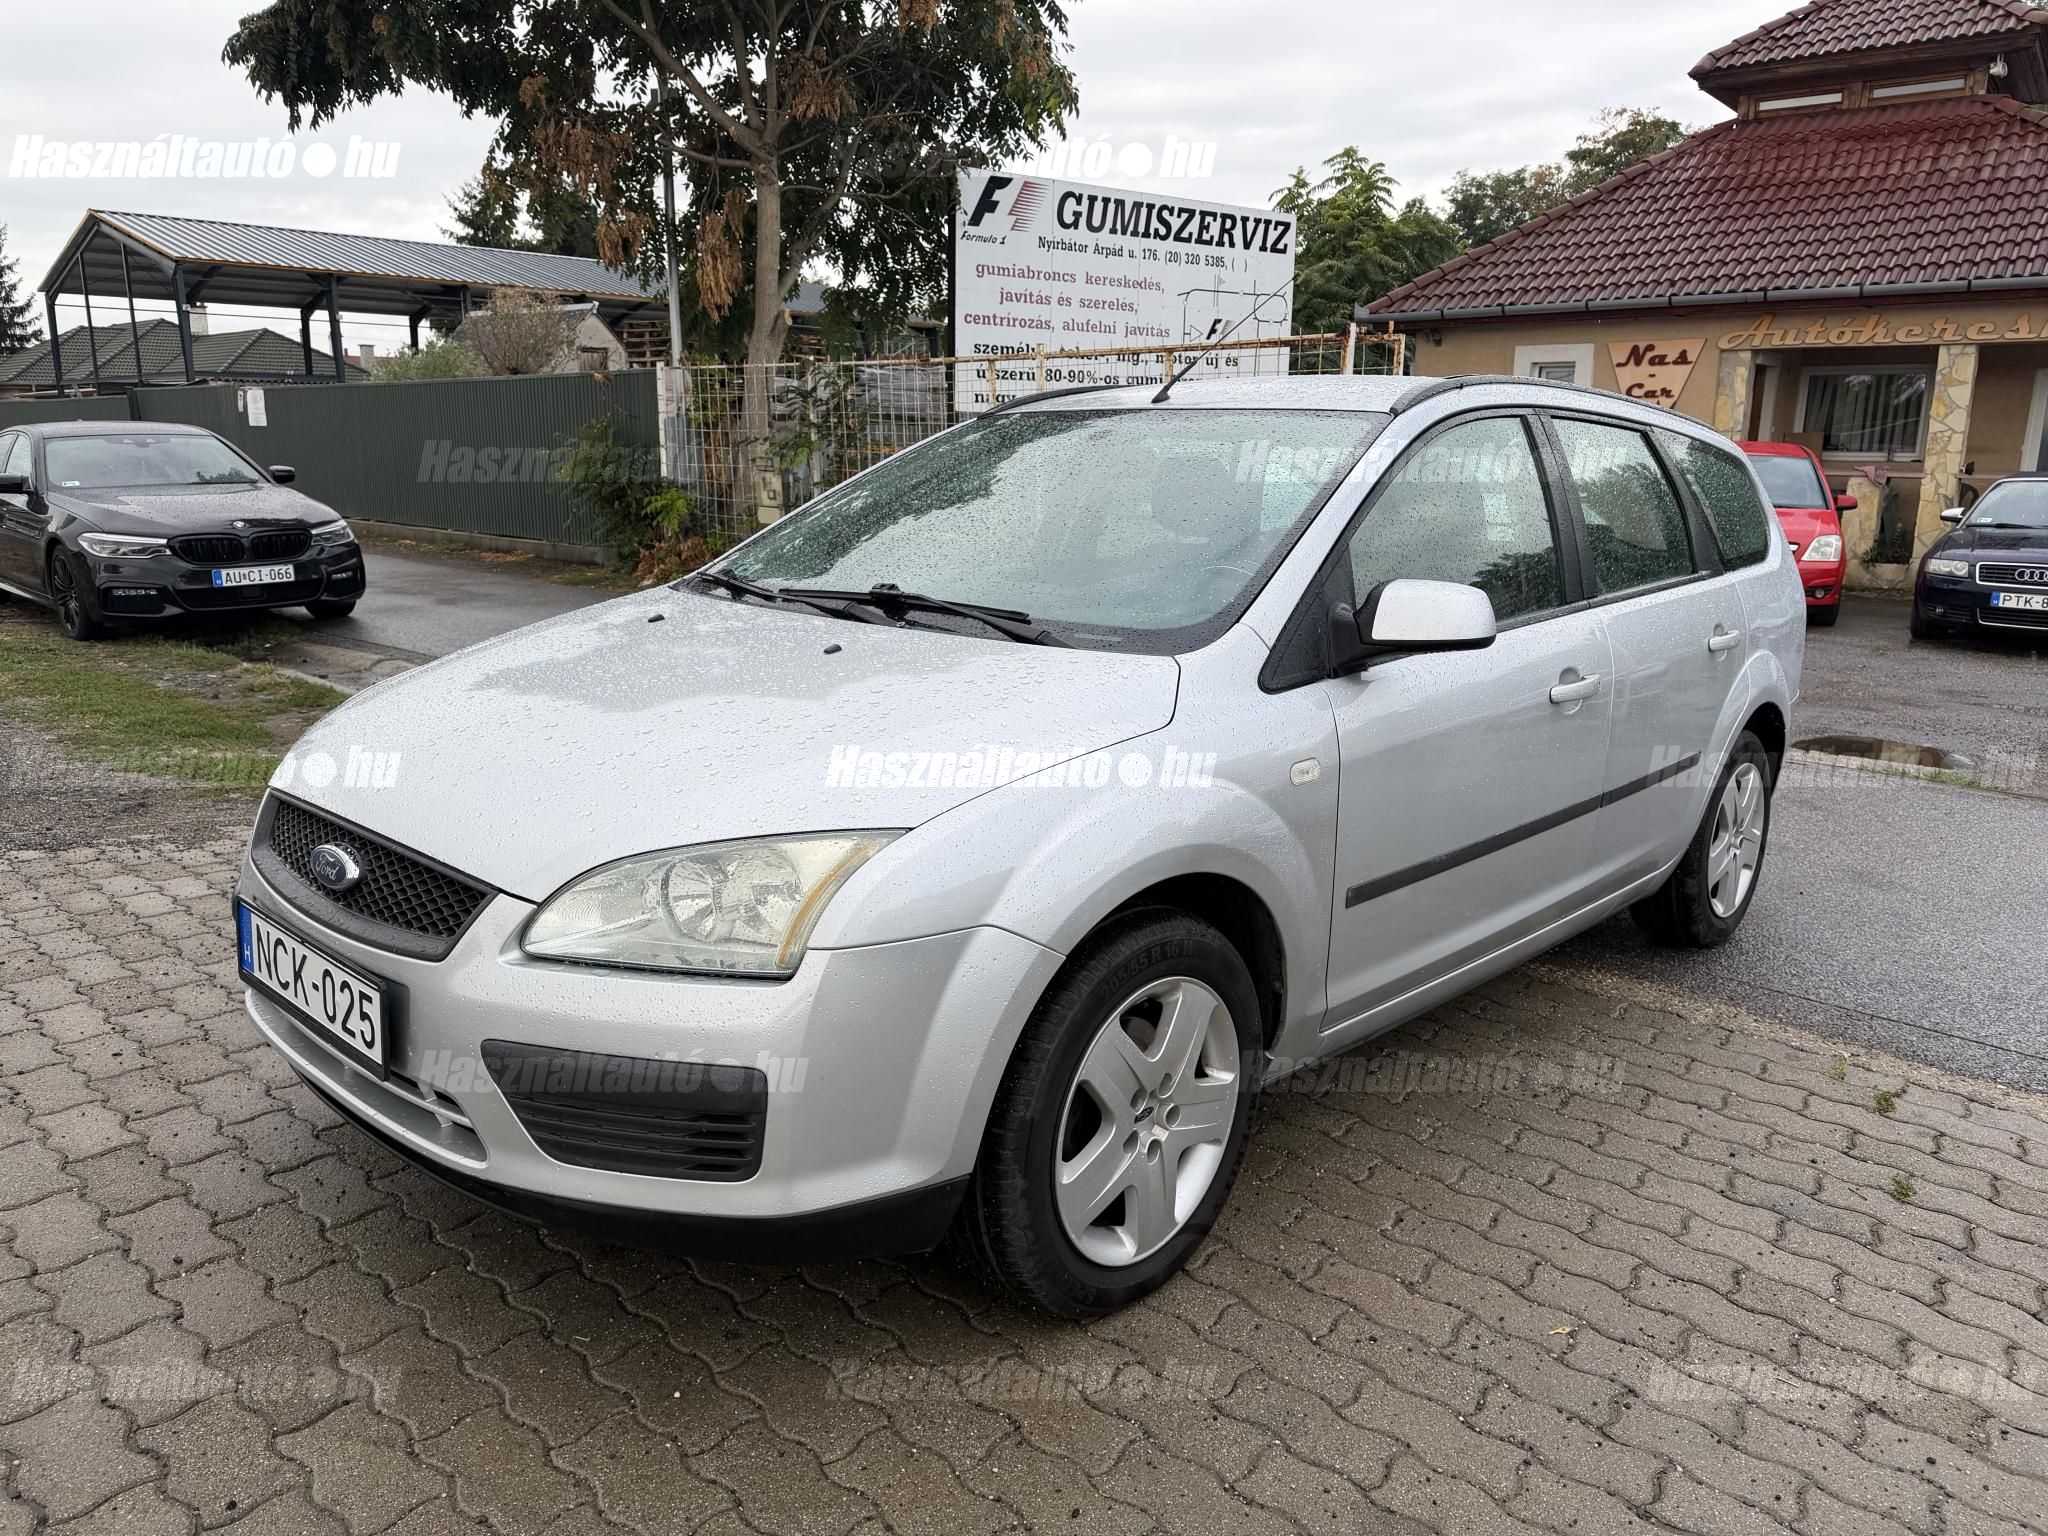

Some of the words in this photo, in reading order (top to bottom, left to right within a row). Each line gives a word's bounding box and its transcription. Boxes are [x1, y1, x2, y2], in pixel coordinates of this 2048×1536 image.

[1057, 190, 1292, 254] GUMISZERVIZ
[960, 230, 997, 244] Formula
[999, 235, 1007, 245] 1
[1038, 235, 1088, 253] Nyírbátor
[1093, 237, 1123, 259] Árpád
[1128, 249, 1137, 259] u.
[1142, 248, 1161, 262] 176.
[1164, 251, 1182, 267] (20)
[1185, 253, 1201, 266] 320
[976, 263, 1077, 283] gumiabroncs
[1085, 271, 1165, 294] kereskedés,
[1000, 287, 1051, 305] javítás
[1057, 292, 1072, 307] és
[1079, 297, 1138, 315] szerelés,
[964, 312, 1055, 333] centrírozás,
[1062, 318, 1117, 335] alufelni
[1124, 321, 1170, 338] javítás
[1716, 311, 2048, 350] Autókeres
[1205, 352, 1219, 370] új
[1225, 353, 1239, 367] és
[1615, 343, 1693, 368] Nas
[1625, 382, 1675, 399] Car
[315, 852, 337, 881] Ford
[255, 922, 376, 1051] NCK-025
